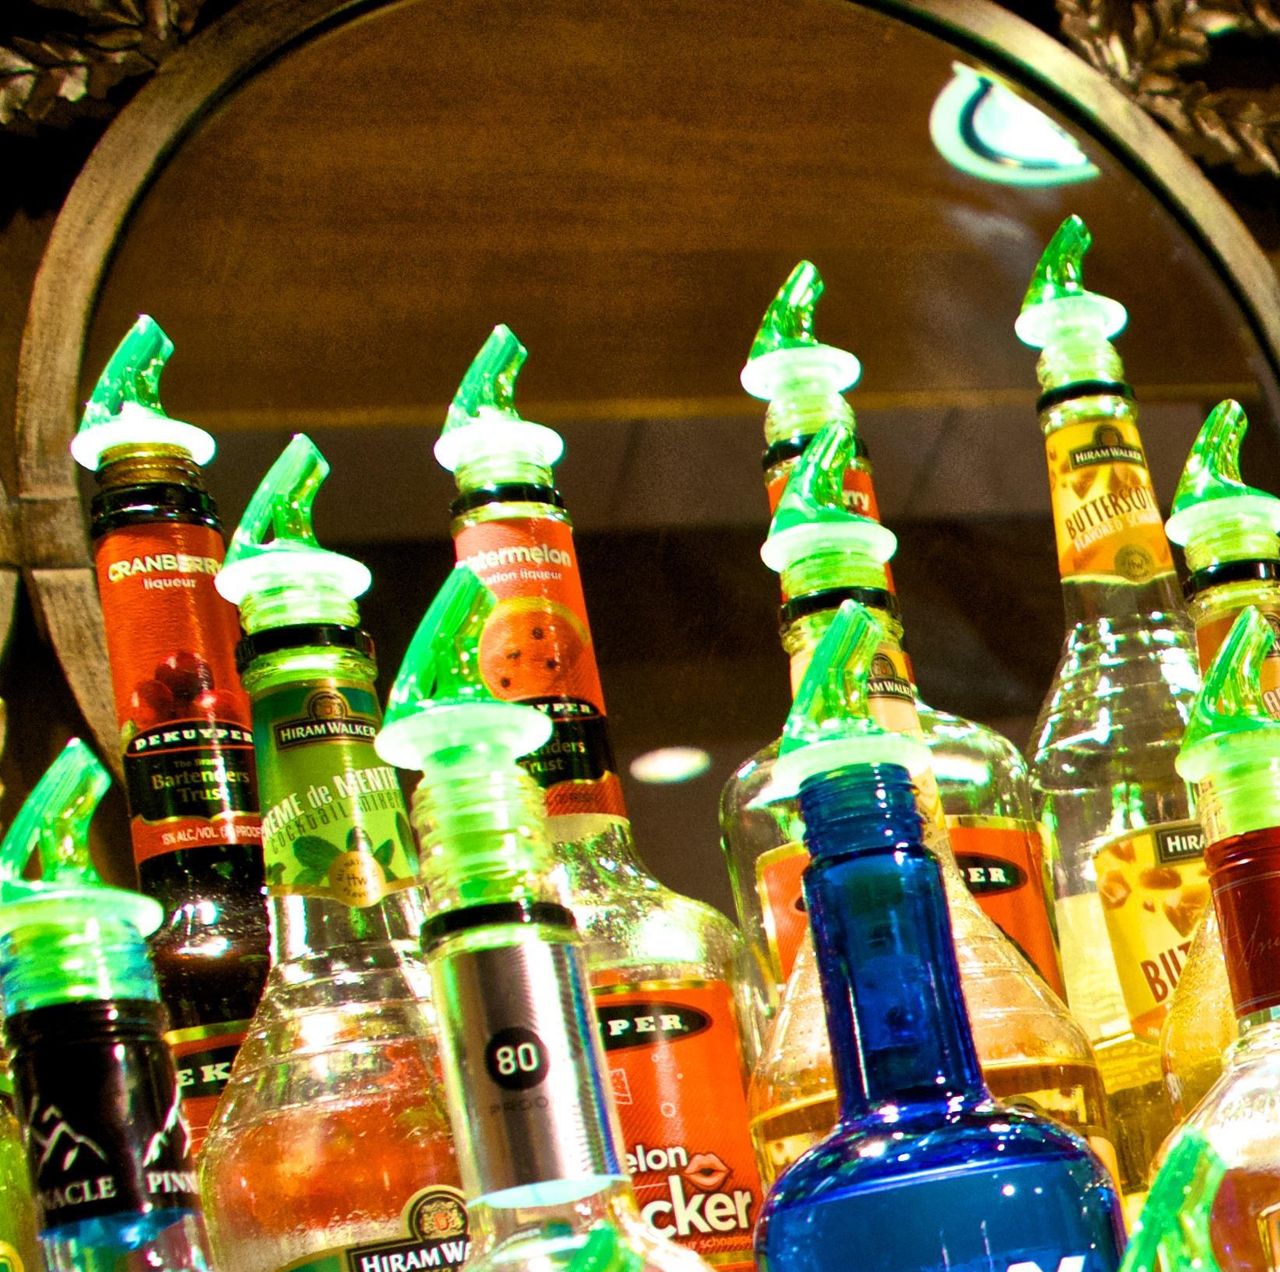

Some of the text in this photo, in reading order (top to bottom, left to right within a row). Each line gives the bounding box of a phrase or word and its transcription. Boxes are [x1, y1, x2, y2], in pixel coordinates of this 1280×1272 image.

[144, 578, 197, 591] liqueur
[519, 569, 562, 581] liqueur
[281, 721, 377, 743] HIRAM WALKER
[152, 771, 249, 790] Bartenders
[306, 767, 400, 810] de MENTH
[271, 803, 348, 854] cocktail
[496, 1042, 539, 1075] 80
[640, 1174, 752, 1240] cker
